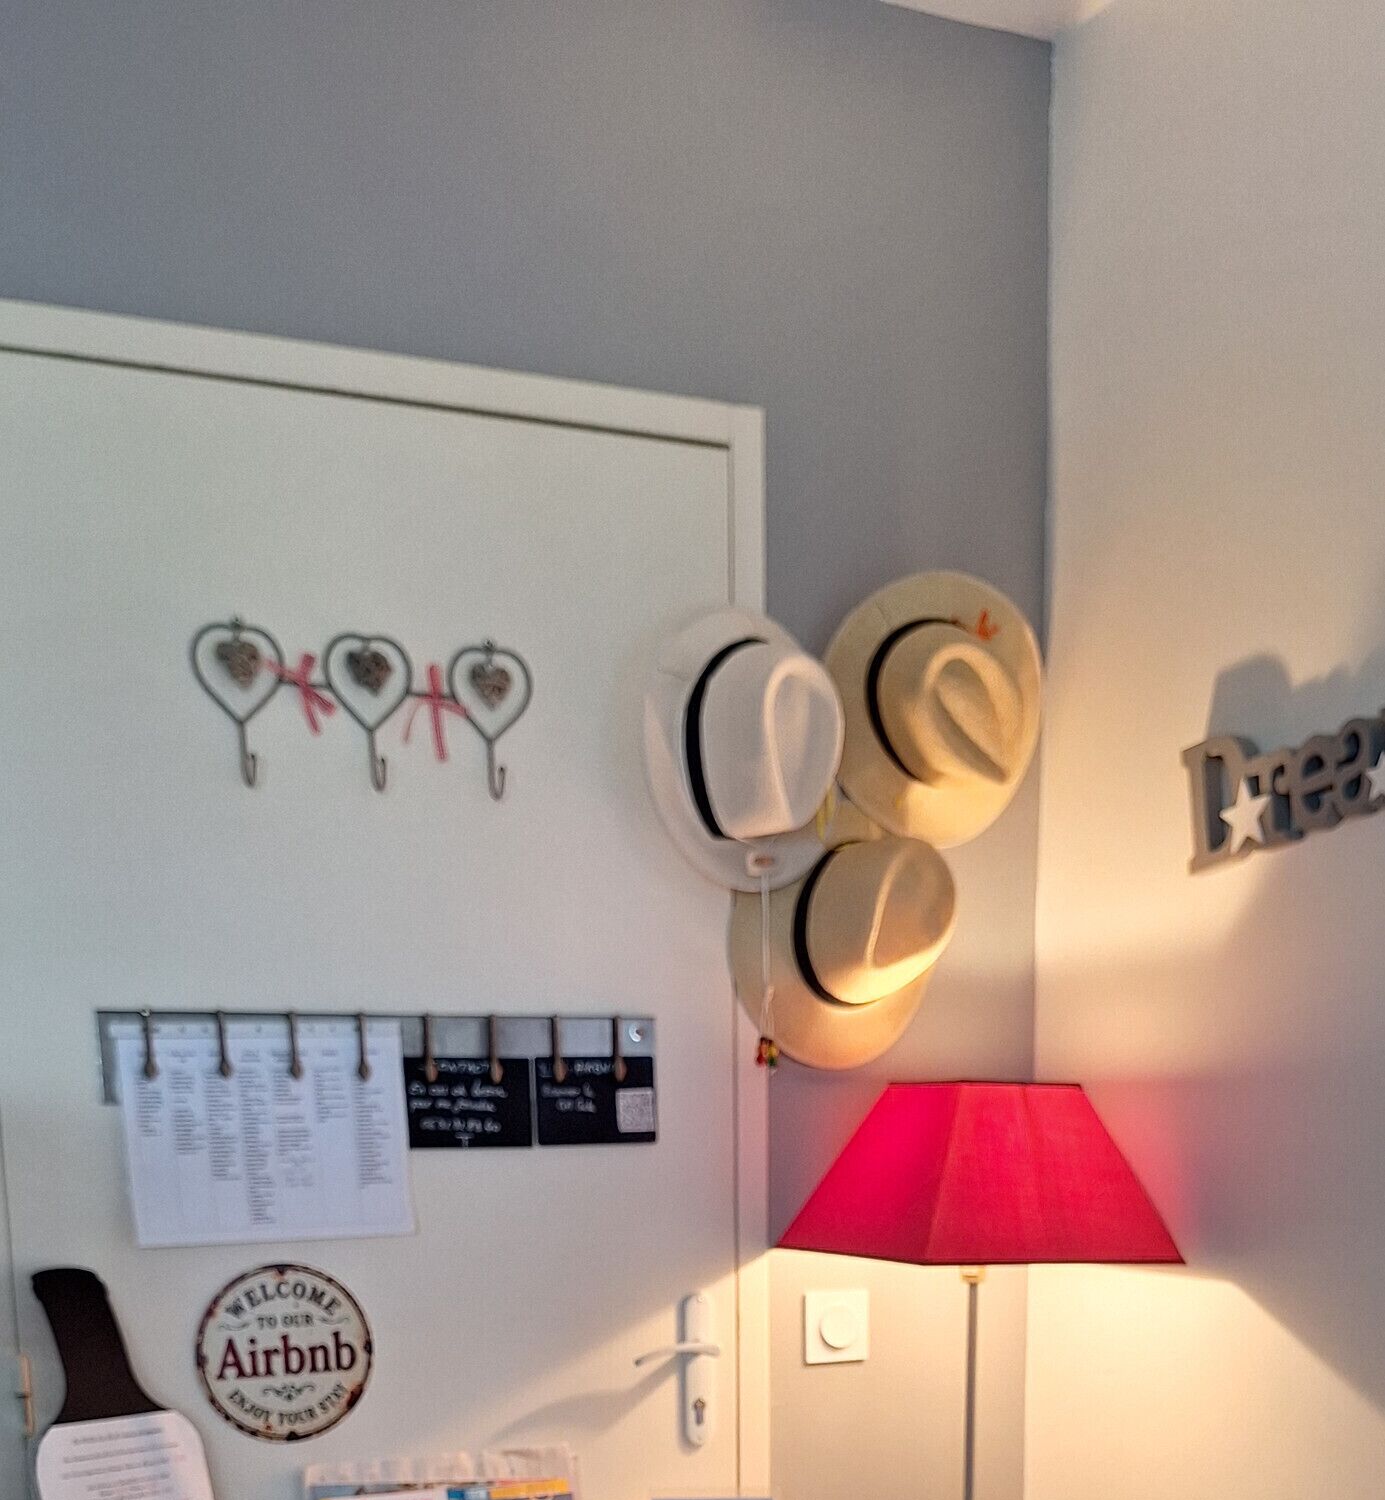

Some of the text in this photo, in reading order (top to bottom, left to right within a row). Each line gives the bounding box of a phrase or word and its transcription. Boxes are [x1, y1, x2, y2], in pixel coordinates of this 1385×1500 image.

[1179, 714, 1385, 876] Drea
[225, 1281, 342, 1319] WELCOME
[257, 1314, 314, 1330] TO OUR
[217, 1331, 357, 1380] Airbnb
[229, 1382, 347, 1426] ENJOY YOUR STAY
